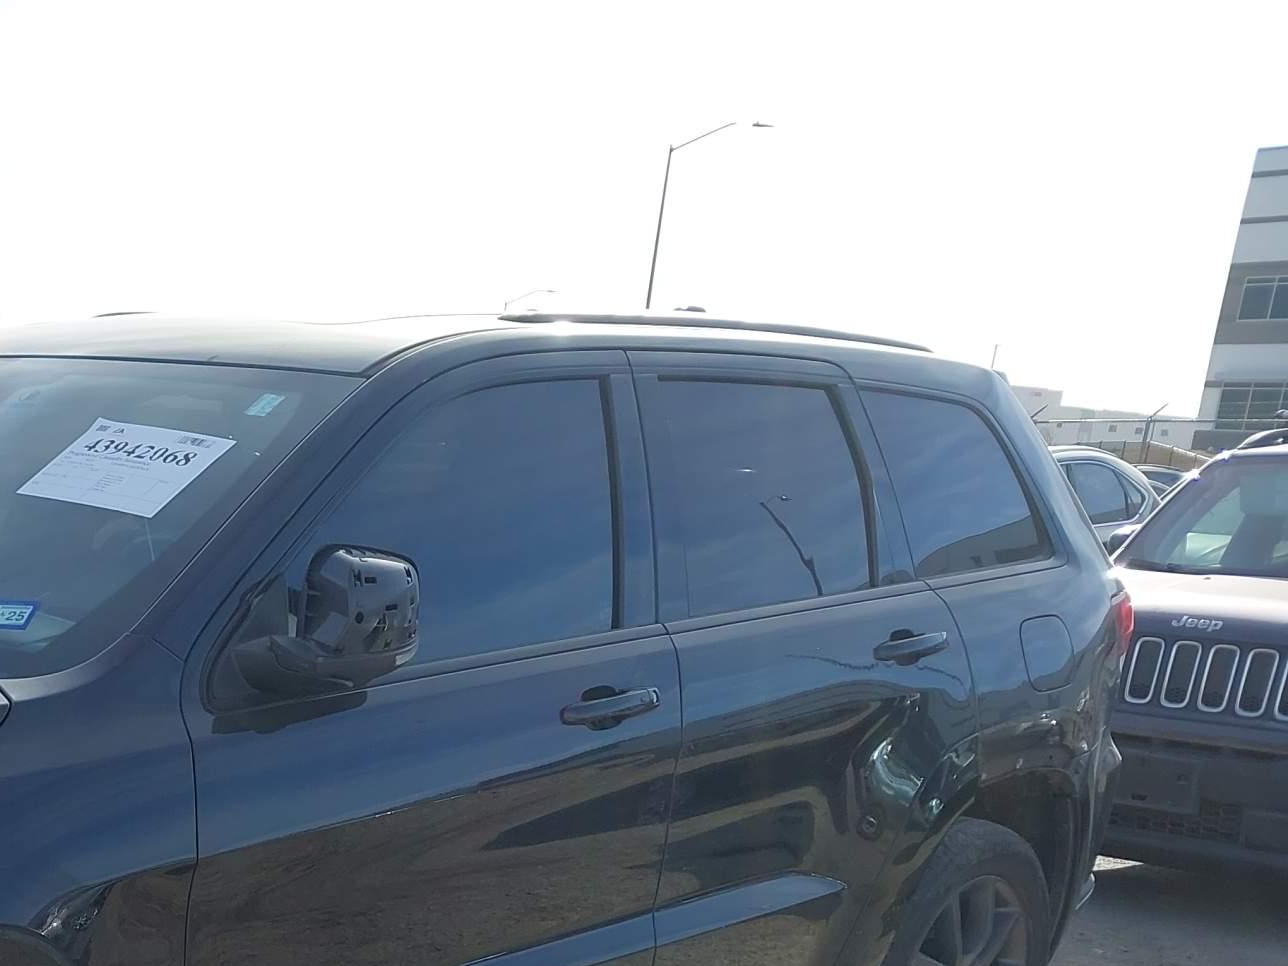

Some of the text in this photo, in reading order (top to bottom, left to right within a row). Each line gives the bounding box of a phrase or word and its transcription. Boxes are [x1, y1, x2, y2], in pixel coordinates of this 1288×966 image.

[84, 438, 199, 467] 43942068
[5, 610, 27, 622] 25
[1171, 615, 1224, 632] Jeep
